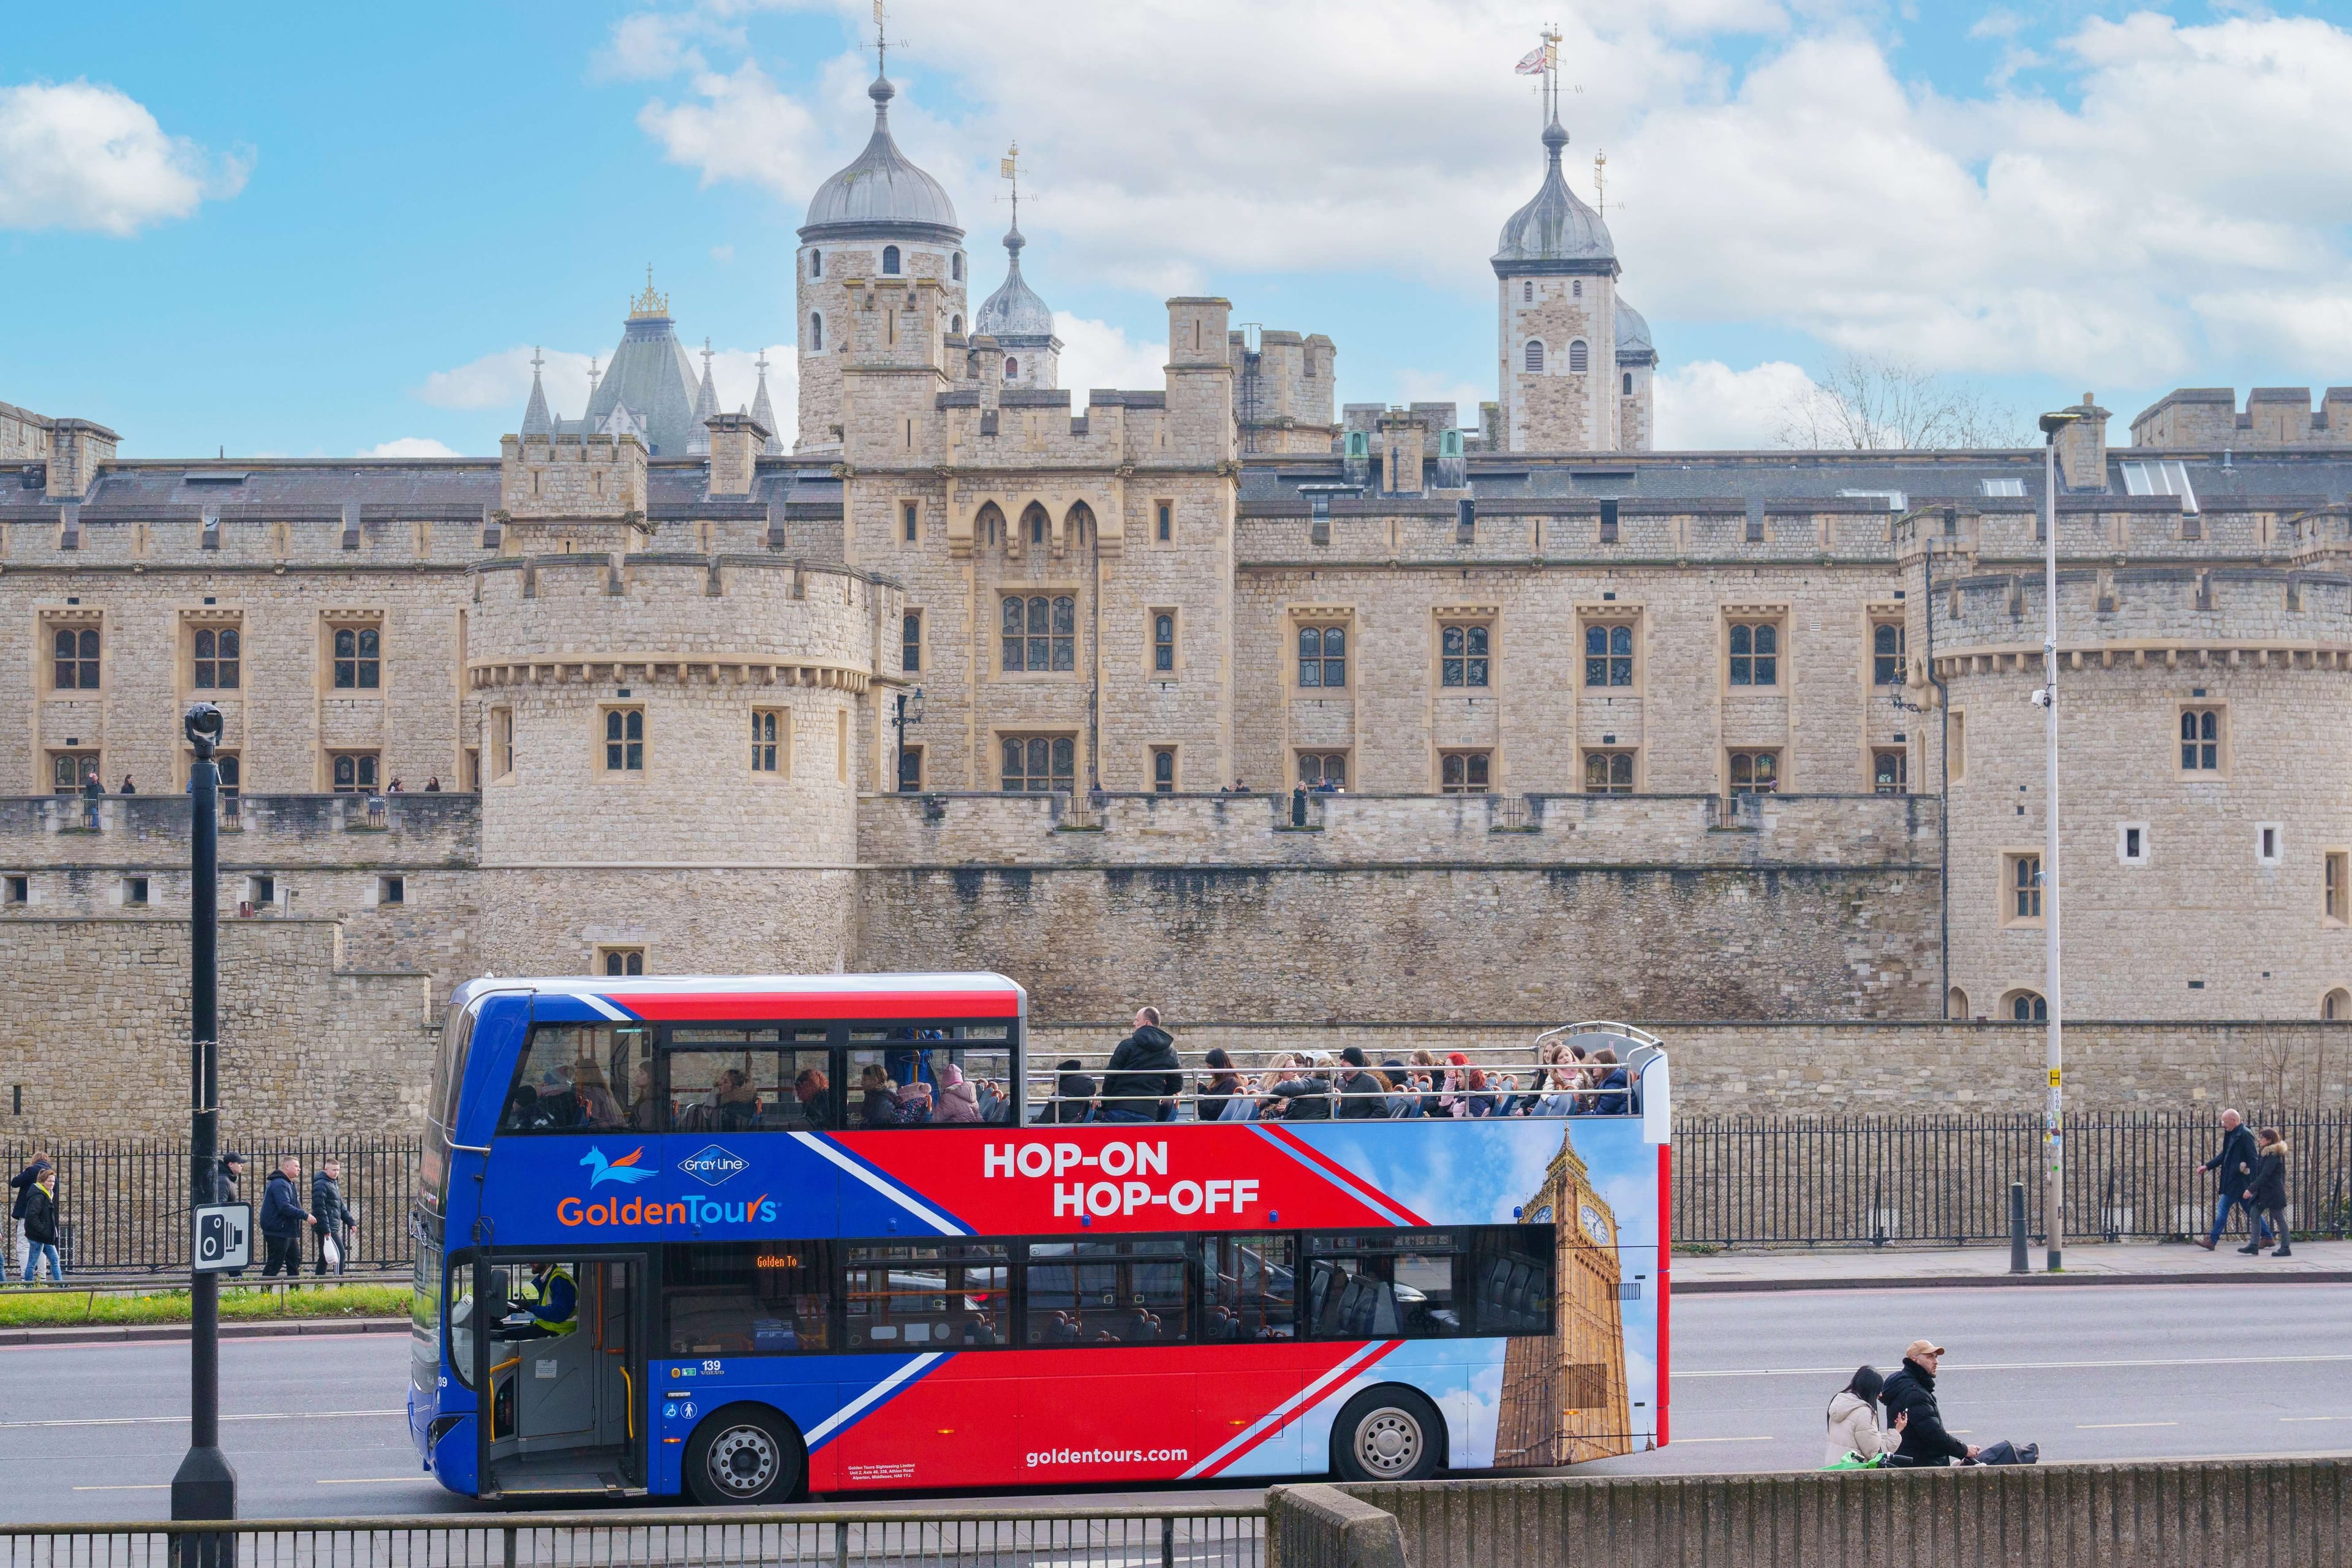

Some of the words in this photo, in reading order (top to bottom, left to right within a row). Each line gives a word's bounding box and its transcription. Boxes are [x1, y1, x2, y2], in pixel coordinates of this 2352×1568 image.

[2050, 1071, 2060, 1085] H
[685, 1159, 717, 1170] Gray
[718, 1158, 743, 1170] Line
[984, 1141, 1167, 1178] HOP-ON
[1054, 1179, 1259, 1217] HOP-OFF
[757, 1256, 785, 1267] Golden
[787, 1256, 797, 1267] To
[702, 1360, 721, 1371] 139
[1026, 1447, 1188, 1468] goldentours.com
